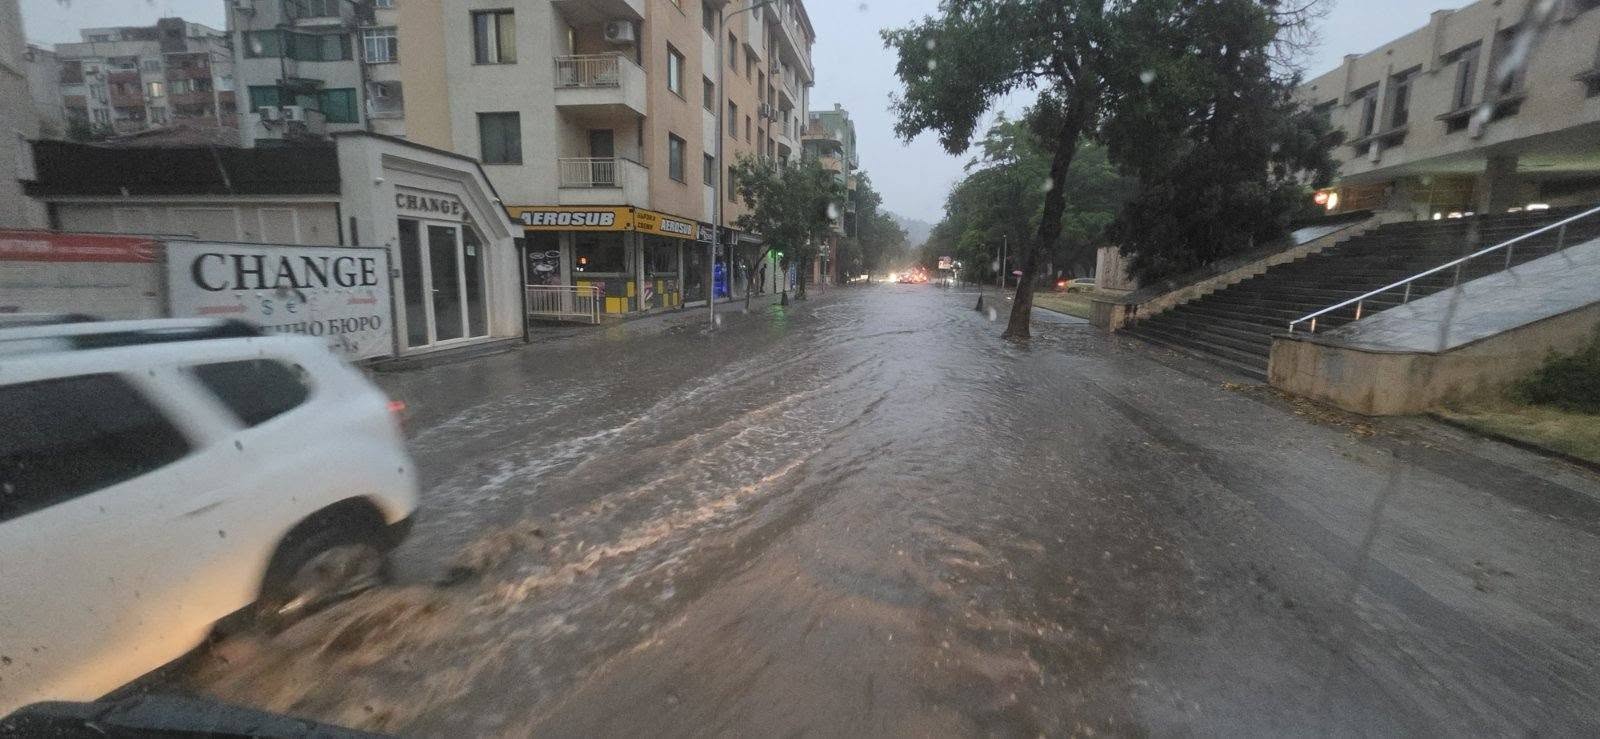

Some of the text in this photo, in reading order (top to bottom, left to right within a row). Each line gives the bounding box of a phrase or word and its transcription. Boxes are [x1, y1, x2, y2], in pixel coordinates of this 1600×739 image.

[396, 193, 460, 215] CHANGE
[521, 211, 615, 226] AEROSUB
[660, 218, 692, 235] AEROSUB
[190, 252, 379, 291] CHANGE
[327, 315, 382, 336] БЮРО
